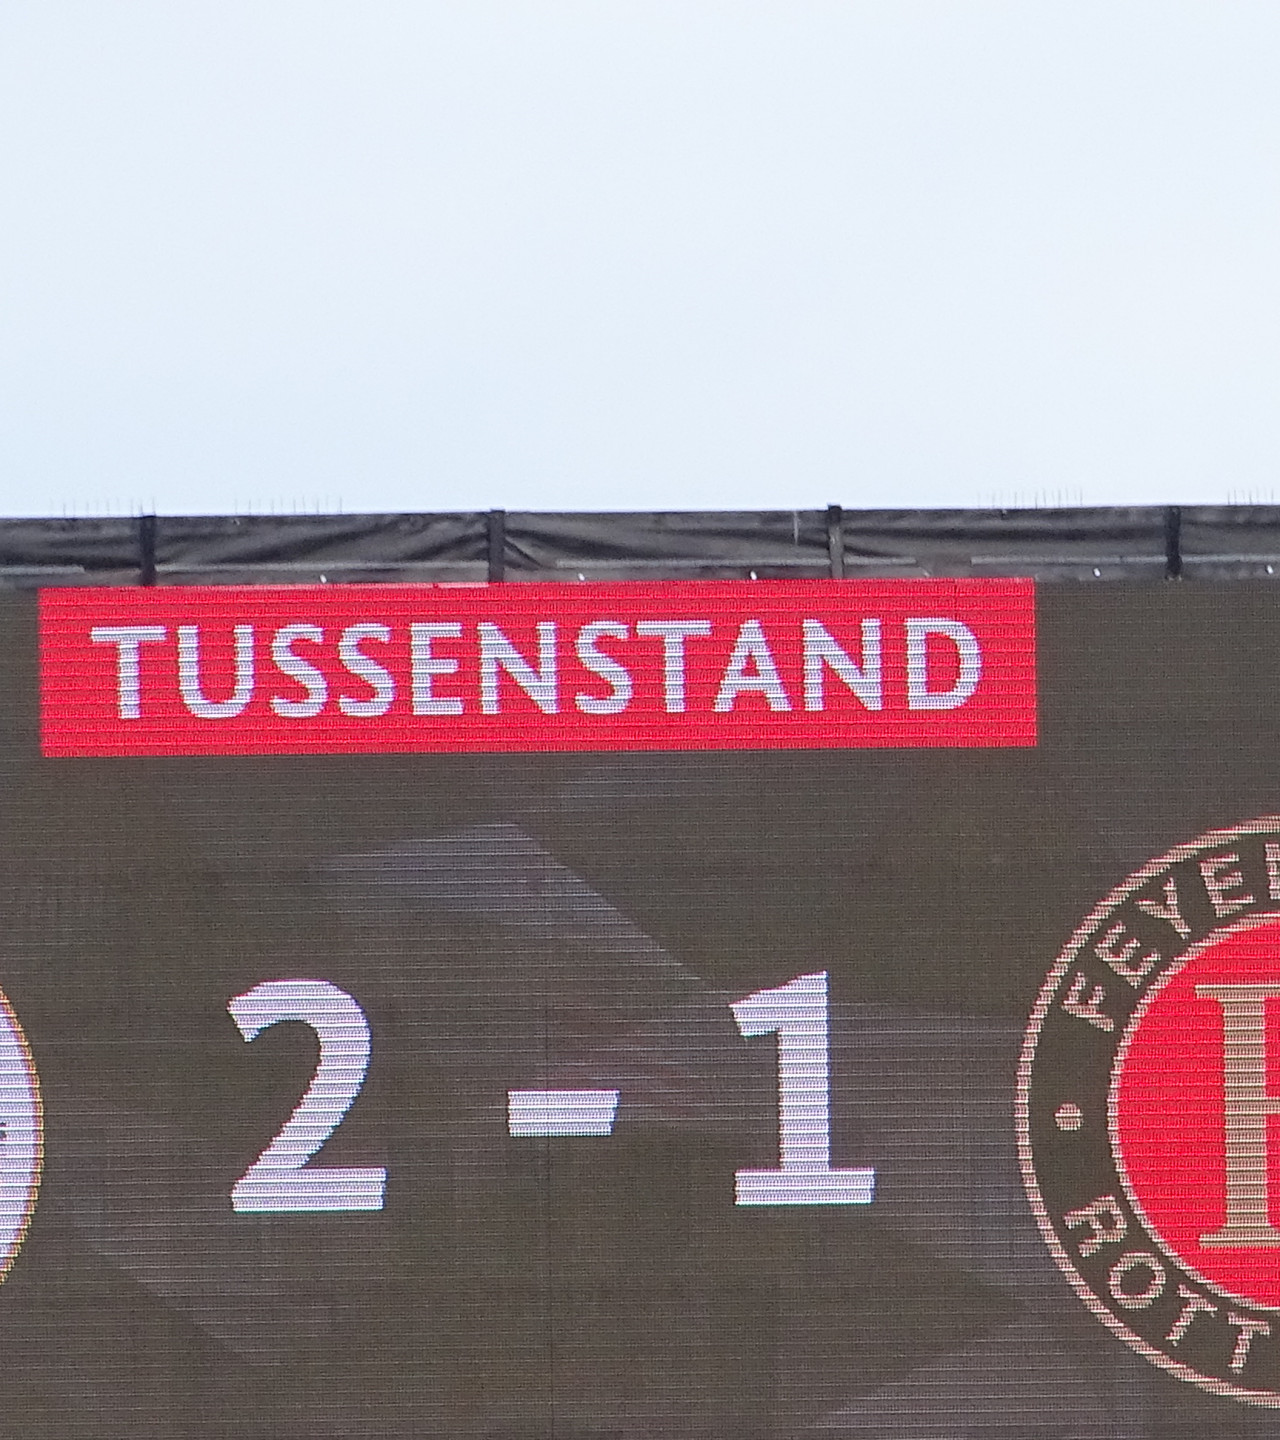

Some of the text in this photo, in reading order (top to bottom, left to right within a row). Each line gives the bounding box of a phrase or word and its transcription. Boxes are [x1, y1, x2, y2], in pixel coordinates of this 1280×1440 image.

[91, 617, 982, 720] TUSSENSTAND
[227, 978, 387, 1212] 2
[729, 970, 875, 1206] 1
